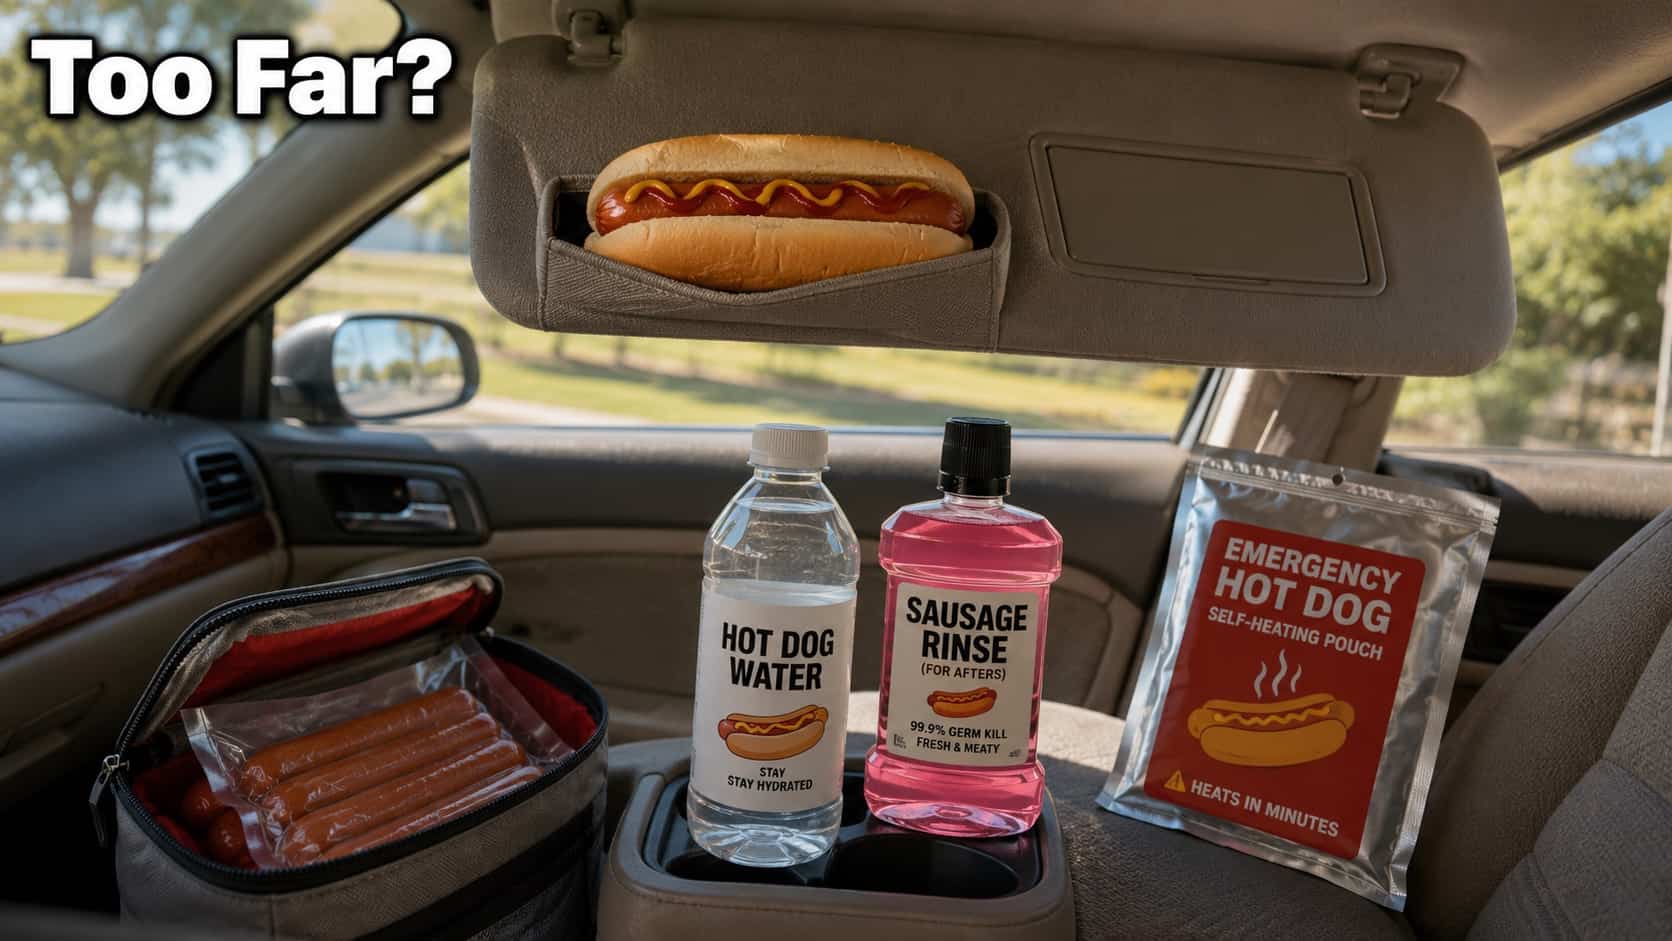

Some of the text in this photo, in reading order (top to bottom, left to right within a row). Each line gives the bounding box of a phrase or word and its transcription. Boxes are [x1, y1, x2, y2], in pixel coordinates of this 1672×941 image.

[1224, 538, 1403, 595] EMERGENCY
[906, 596, 1028, 631] SAUSAGE
[1214, 566, 1394, 634] HOT DOG
[722, 622, 834, 658] HOT DOG
[921, 630, 1009, 664] RINSE
[1207, 606, 1384, 661] SELF-HEATING POUCH
[730, 656, 822, 691] WATER
[921, 662, 1006, 682] (FOR AFTERS)
[910, 721, 1008, 739] 99.9% GERM KILL
[916, 737, 951, 752] FRESH
[954, 743, 961, 753] &
[964, 743, 1001, 754] MEATY
[727, 775, 812, 792] STAY HYDRATED
[759, 767, 786, 778] STAY
[1190, 779, 1340, 838] HEATS IN MINUTES
